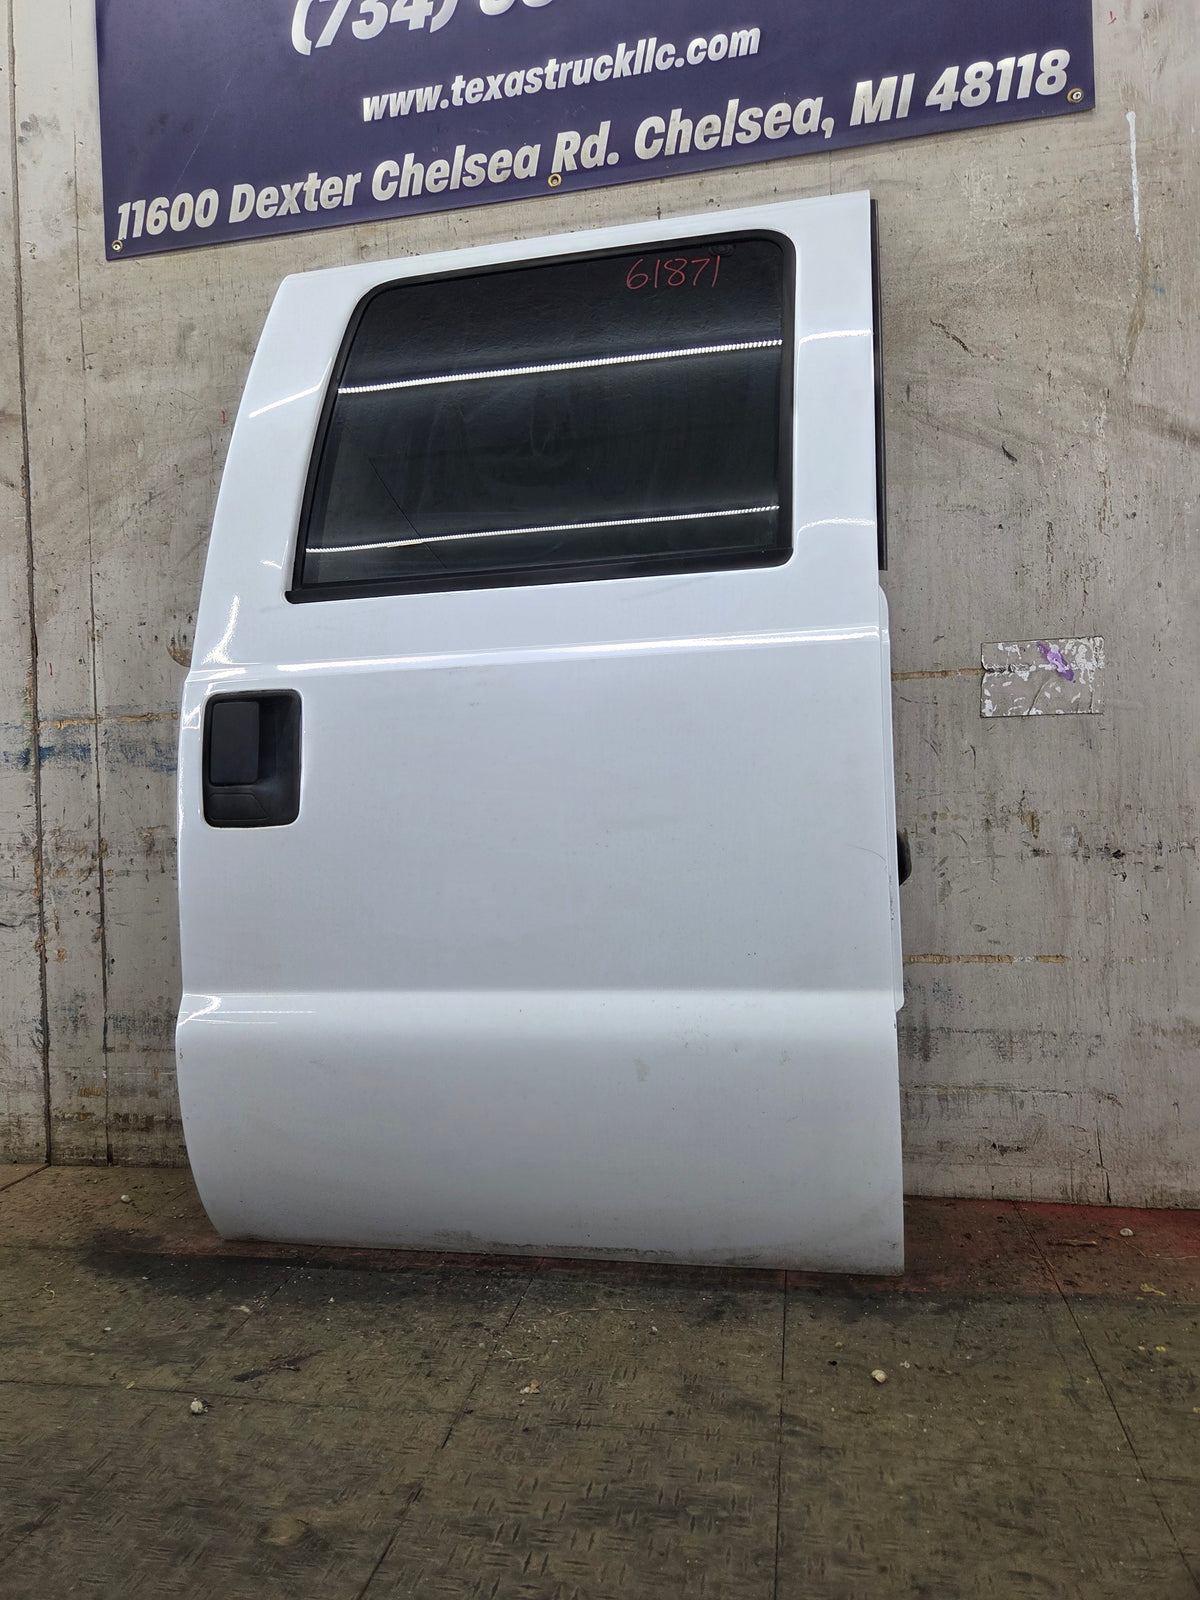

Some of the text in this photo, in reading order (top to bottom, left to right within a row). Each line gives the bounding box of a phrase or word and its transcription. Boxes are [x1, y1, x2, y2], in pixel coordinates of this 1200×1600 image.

[362, 26, 761, 122] www.texastruckllc.com
[116, 48, 1070, 241] 11600 Dexter Chelsea Rd. Chelsea, MI 48118
[626, 255, 720, 290] 61871
